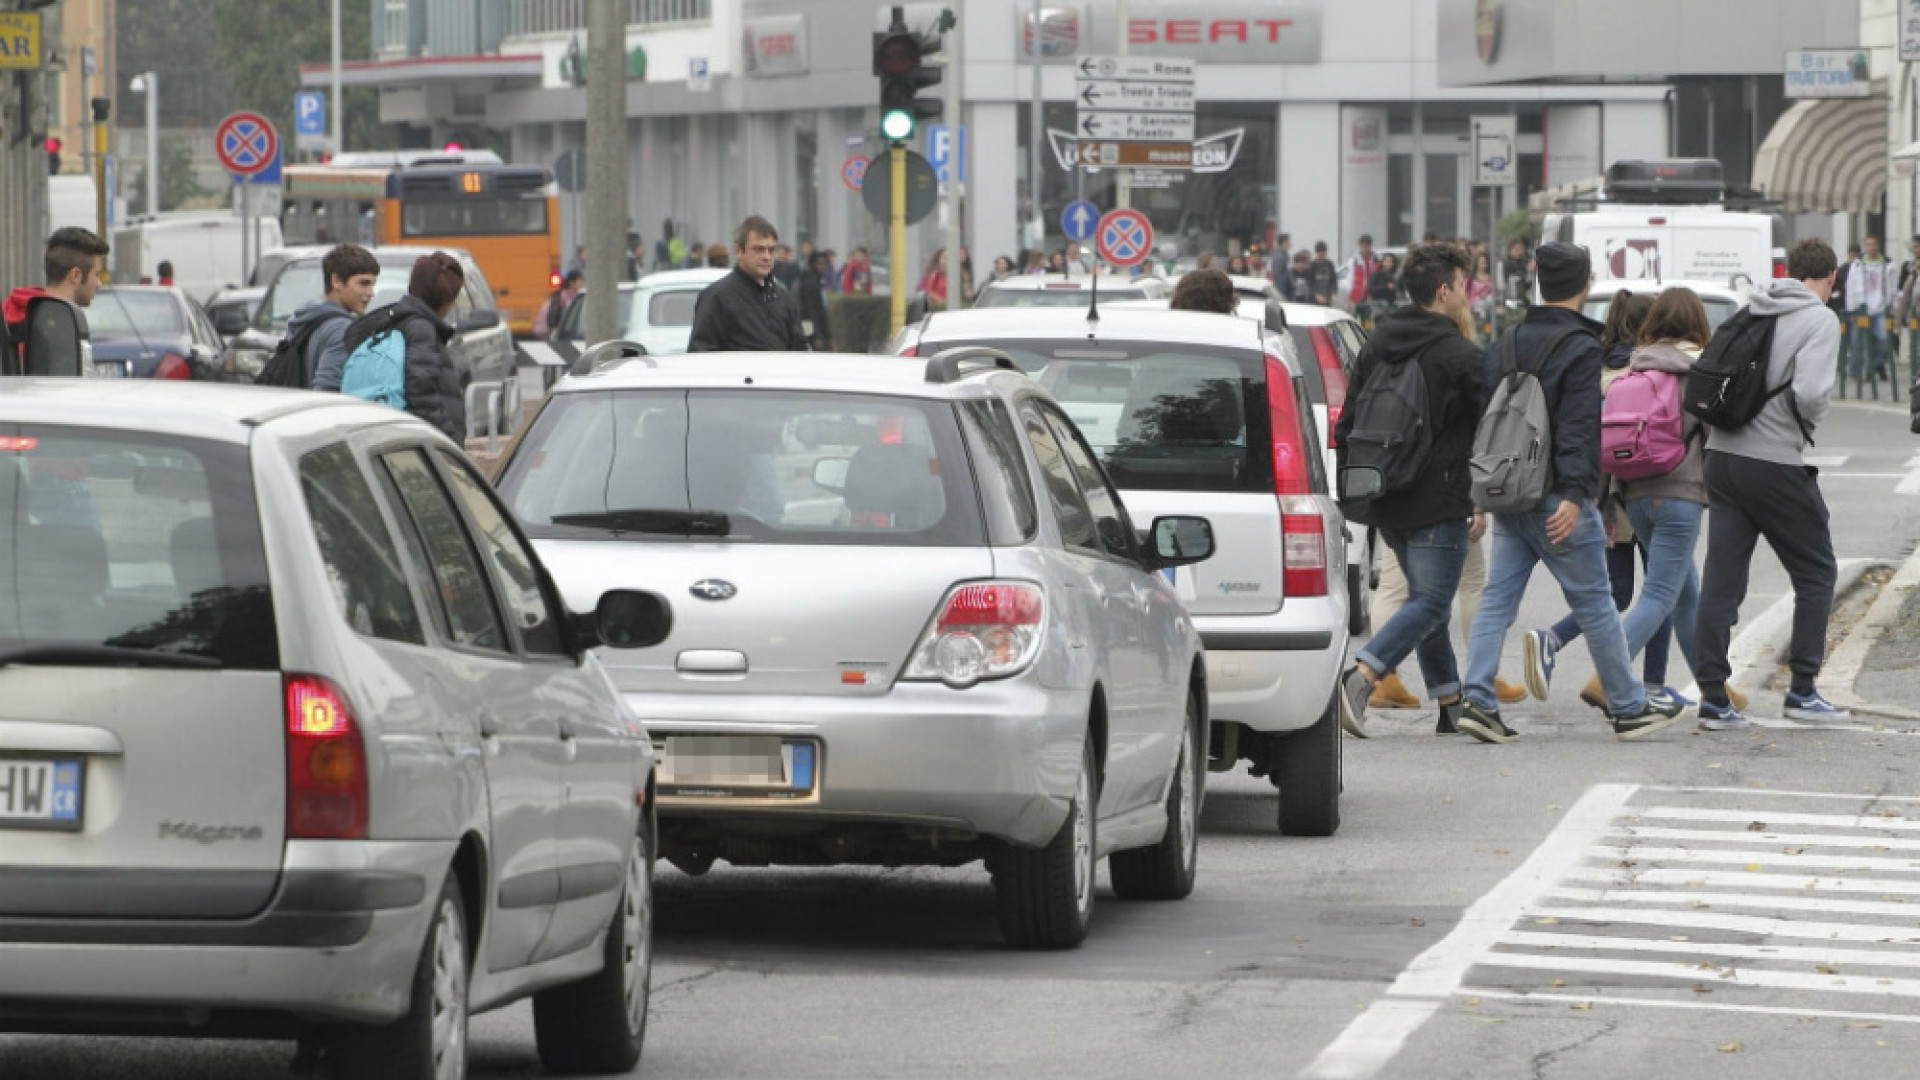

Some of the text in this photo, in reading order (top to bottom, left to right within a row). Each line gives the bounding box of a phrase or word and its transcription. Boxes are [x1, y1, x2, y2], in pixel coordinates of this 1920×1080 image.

[1128, 19, 1293, 44] SEAT
[1154, 62, 1193, 75] Roma
[1801, 53, 1834, 68] Bar
[301, 97, 318, 118] P
[55, 790, 75, 812] CR
